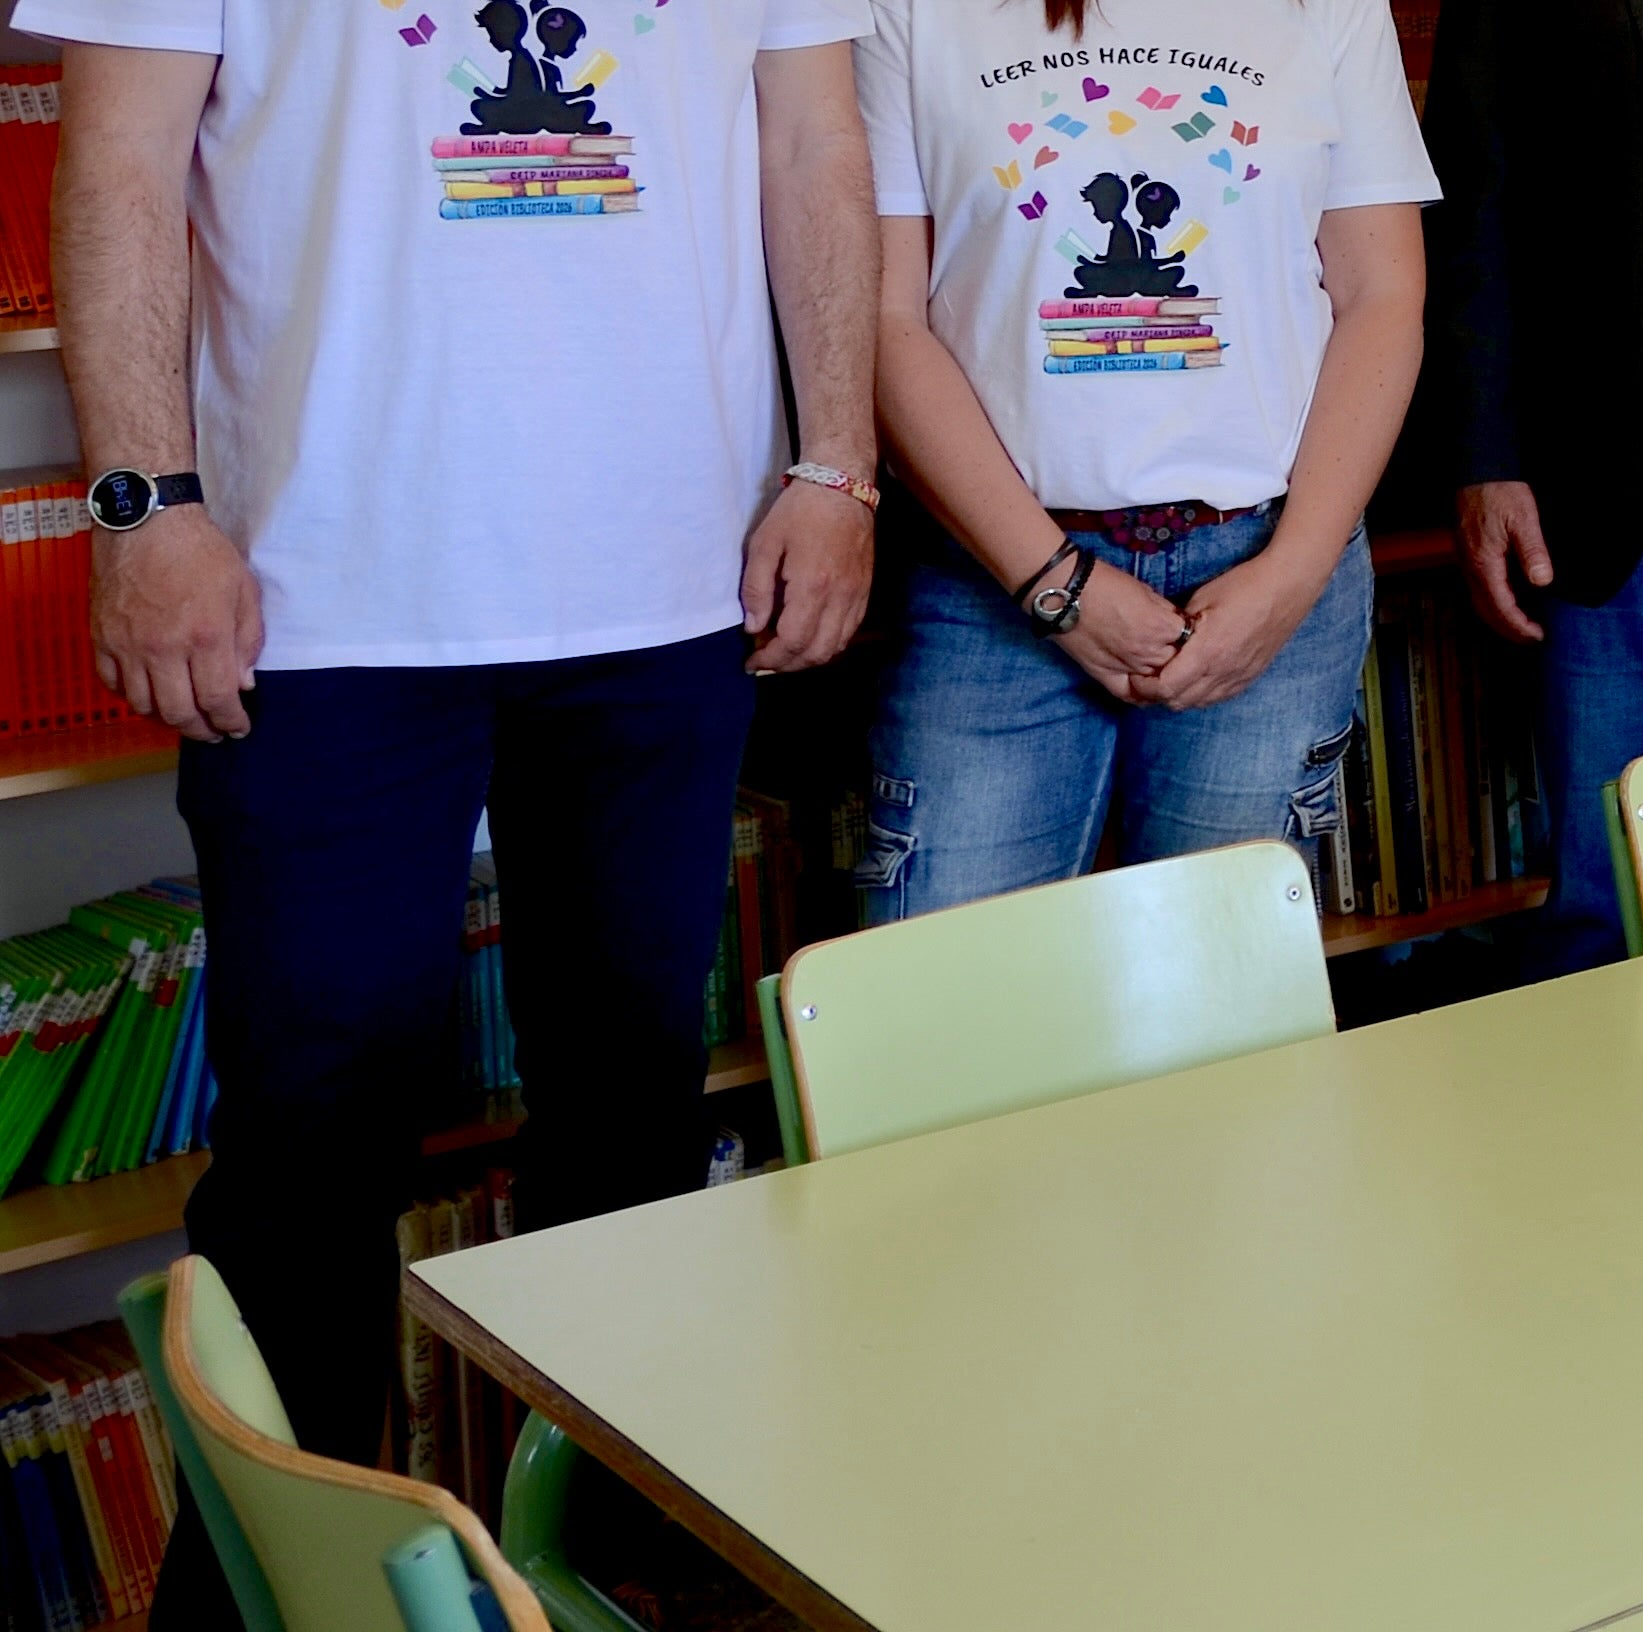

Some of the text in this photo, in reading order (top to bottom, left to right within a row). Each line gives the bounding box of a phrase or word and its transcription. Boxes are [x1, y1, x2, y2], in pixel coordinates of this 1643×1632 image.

[980, 47, 1265, 88] LEER NOS HACE IGUALES
[511, 202, 554, 216] BIBLIOTECA
